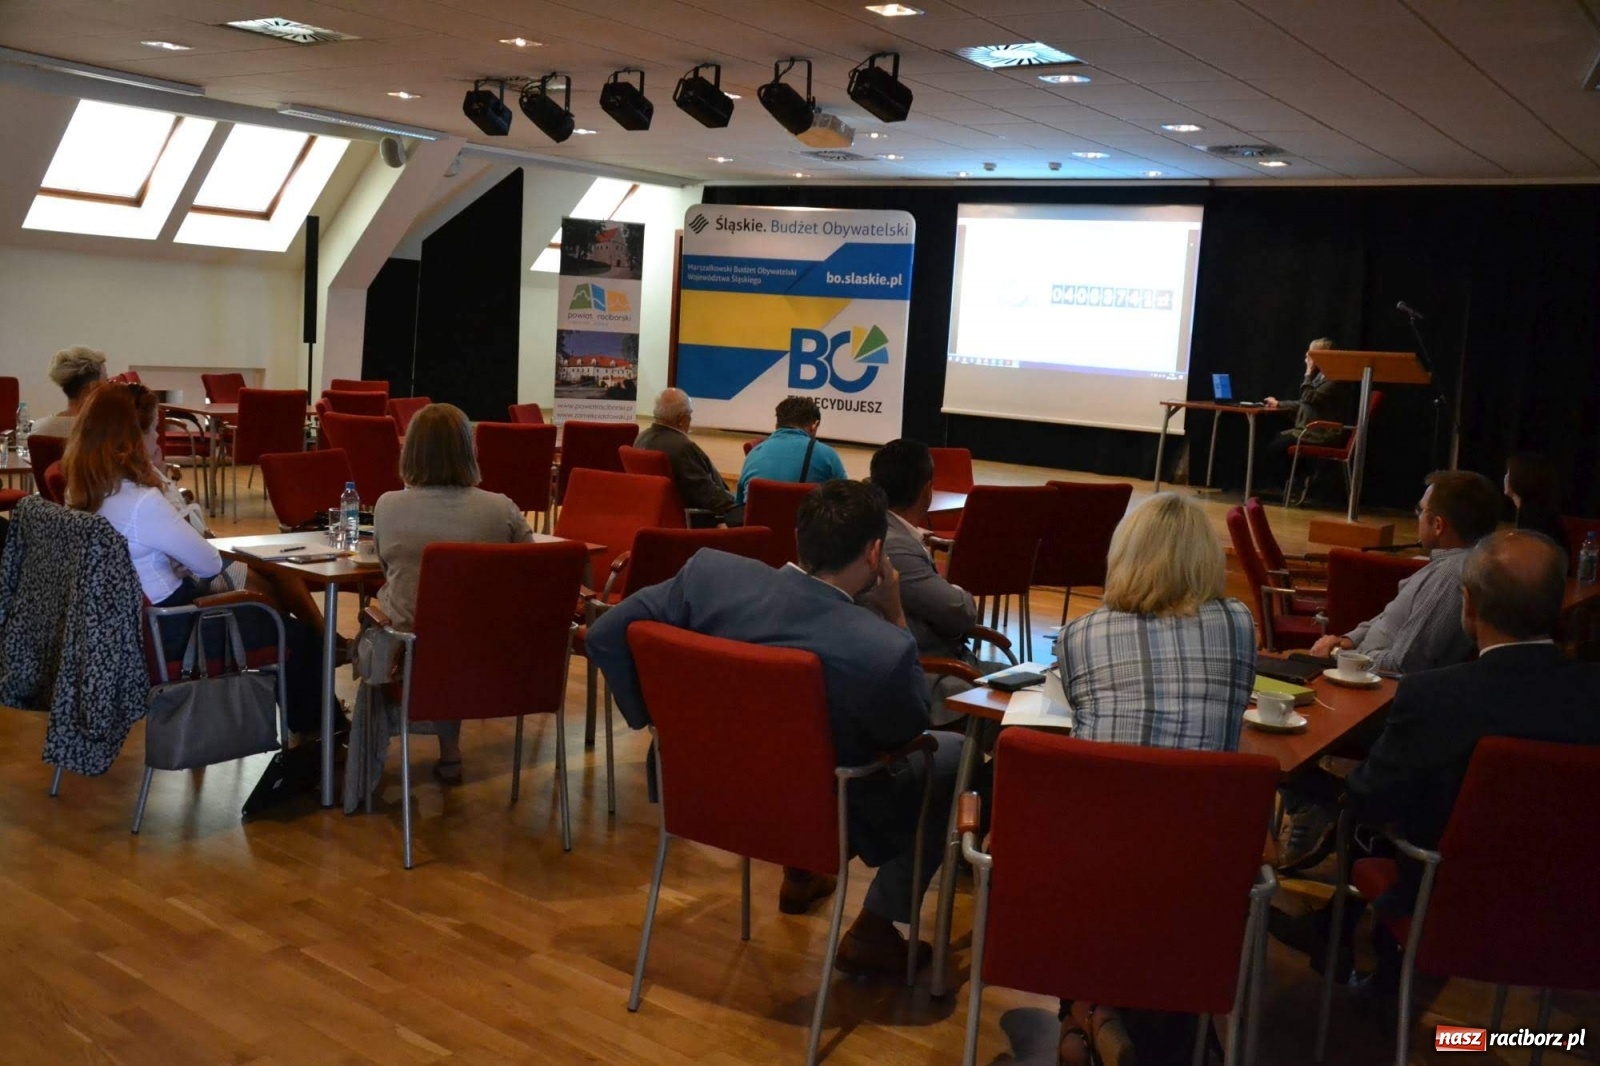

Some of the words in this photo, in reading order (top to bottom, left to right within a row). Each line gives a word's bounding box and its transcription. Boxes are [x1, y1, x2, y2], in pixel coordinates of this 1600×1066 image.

[715, 215, 767, 235] Śląskie.
[771, 219, 818, 235] Budżet
[822, 221, 909, 239] Obywatelski
[687, 263, 732, 274] Marszałkowski
[733, 265, 756, 275] Budżet
[757, 267, 798, 277] Obywatelski
[687, 273, 730, 283] Województwa
[731, 275, 762, 286] Śląskiego
[826, 271, 903, 289] bo.slaskie.pl
[567, 312, 593, 320] powiat
[597, 314, 632, 322] raciborski
[806, 397, 883, 414] ECYDUJESZ
